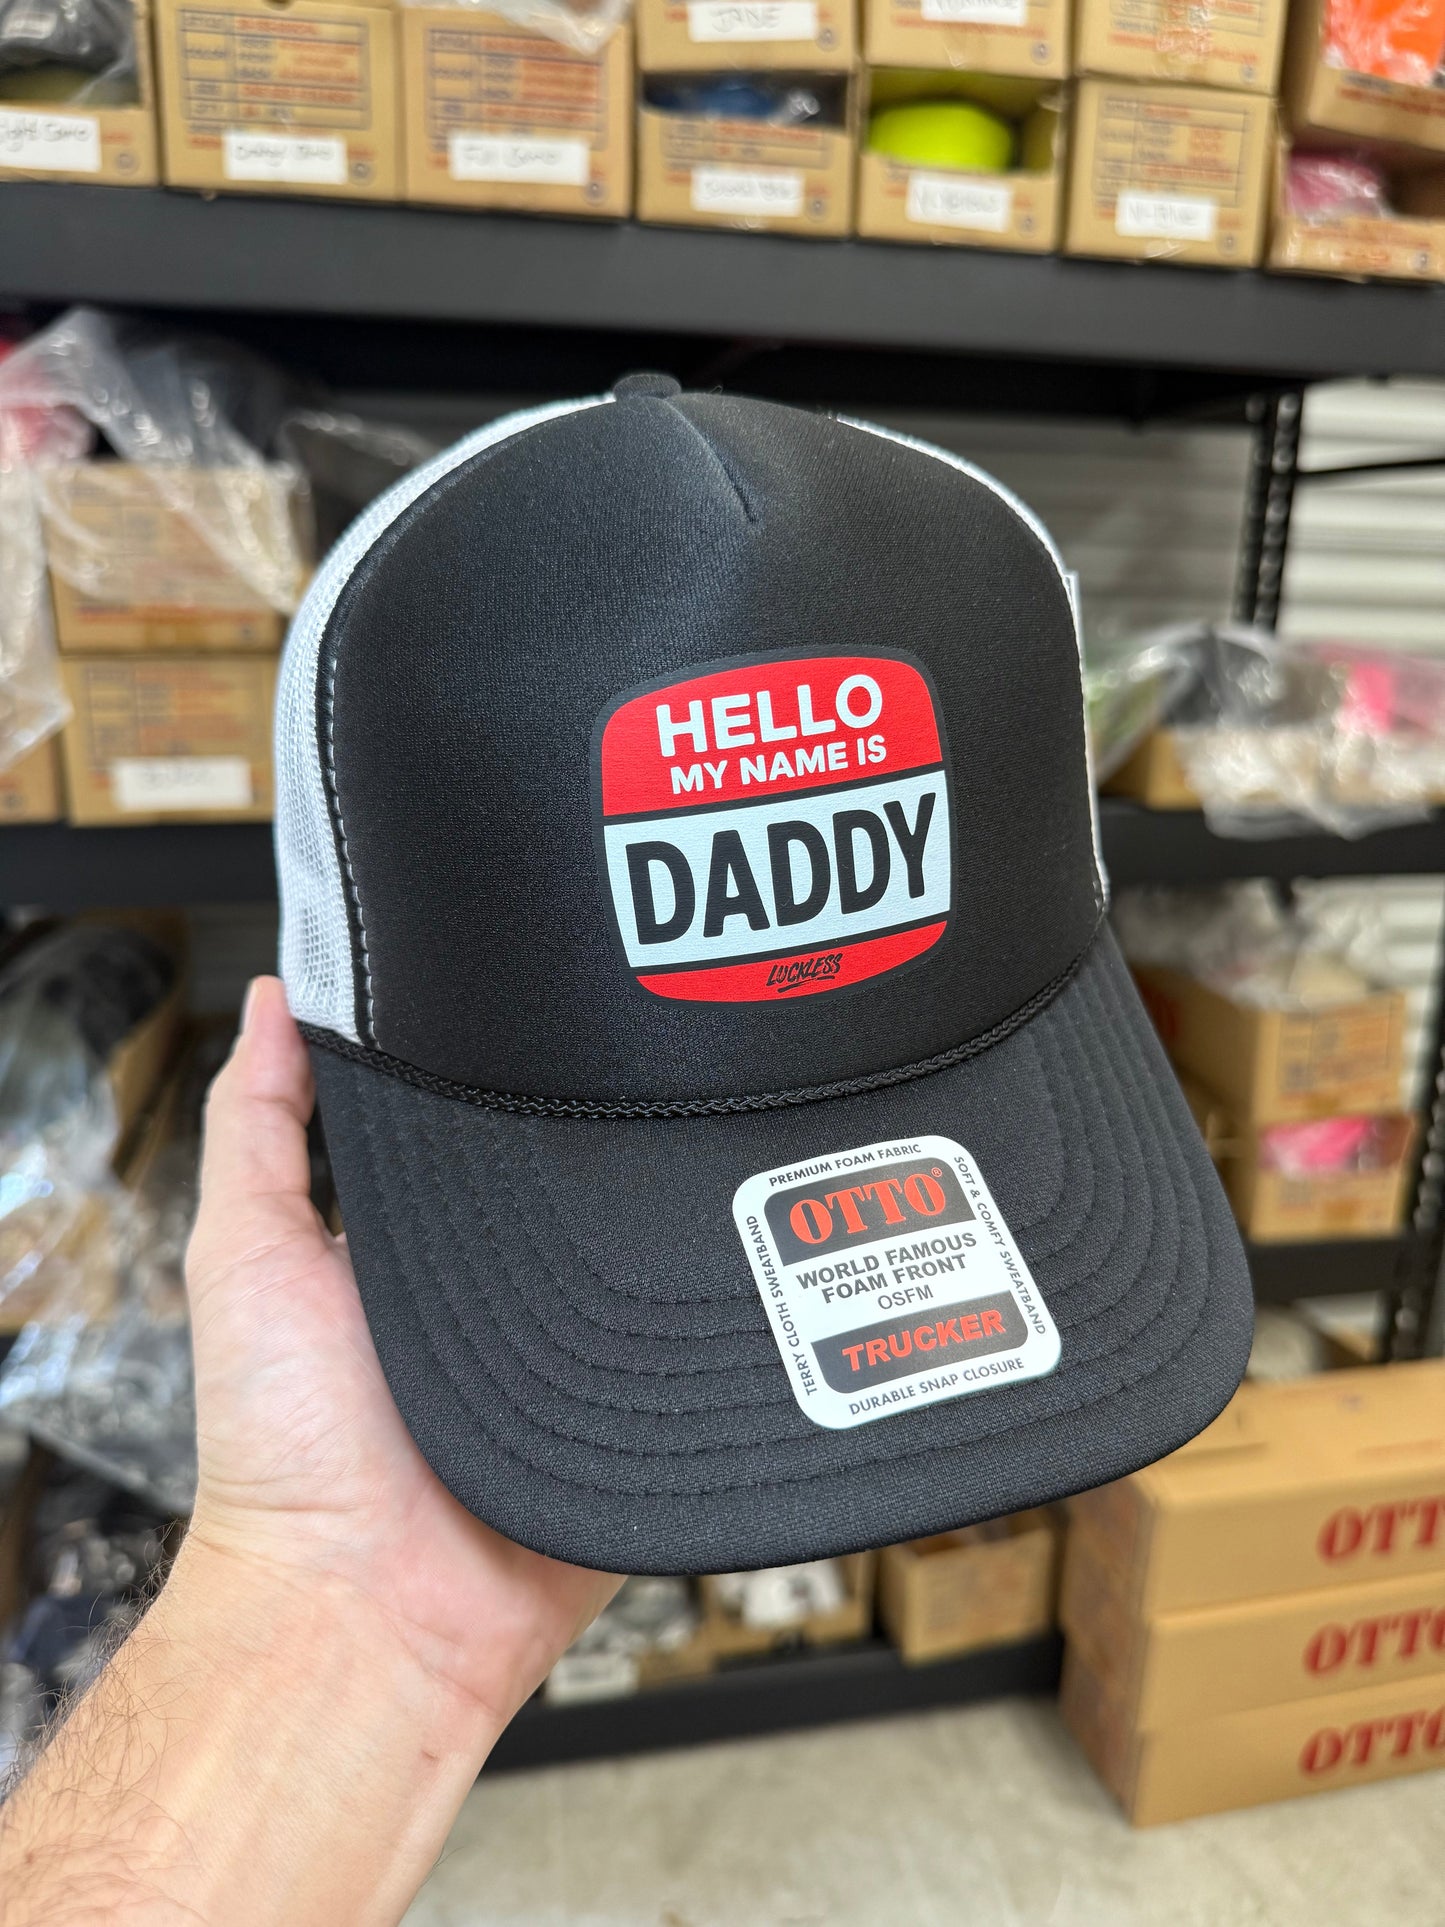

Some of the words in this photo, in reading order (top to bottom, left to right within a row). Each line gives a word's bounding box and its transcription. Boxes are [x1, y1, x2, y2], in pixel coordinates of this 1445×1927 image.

[656, 674, 883, 757] HELLO
[670, 760, 728, 794] MY
[740, 742, 848, 785] NAME
[857, 734, 887, 765] IS
[625, 792, 937, 945] DADDY
[766, 953, 842, 990] LUCKLESS
[768, 1162, 833, 1187] PREMIUM
[835, 1151, 876, 1170] FOAM
[878, 1143, 922, 1160] FABRIC
[746, 1215, 784, 1298] SWEATBAND
[796, 1254, 880, 1290] WORLD
[885, 1232, 978, 1264] FAMOUS
[953, 1155, 975, 1188] SOFT
[970, 1189, 980, 1199] &
[976, 1202, 1007, 1247] COMFY
[1000, 1250, 1047, 1336] SWEATBAND
[821, 1273, 889, 1304] FOAM
[892, 1253, 968, 1285] FRONT
[877, 1284, 935, 1310] OSFM
[774, 1301, 800, 1349] CLOTH
[842, 1308, 1007, 1372] TRUCKER
[792, 1351, 817, 1396] TERRY
[848, 1385, 916, 1416] DURABLE
[919, 1372, 959, 1395] SNAP
[962, 1357, 1025, 1382] CLOSURE
